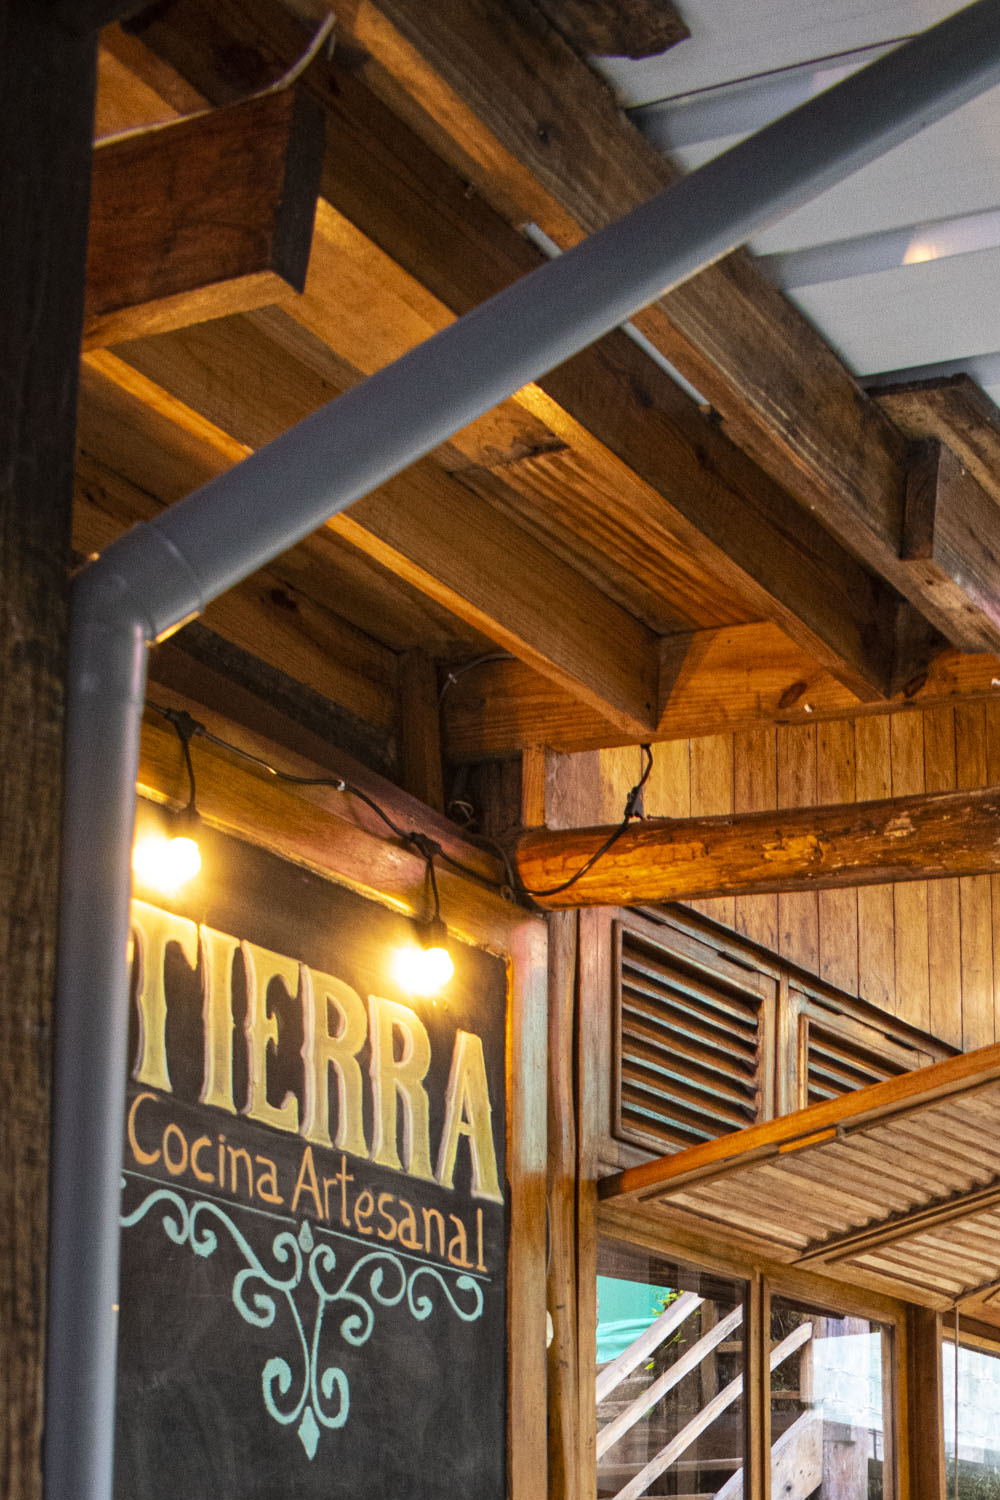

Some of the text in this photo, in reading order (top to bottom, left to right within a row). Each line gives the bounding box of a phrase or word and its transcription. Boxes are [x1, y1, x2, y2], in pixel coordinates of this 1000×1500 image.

[127, 898, 504, 1204] TIERRA
[128, 1091, 488, 1272] Cocina Artesanal
